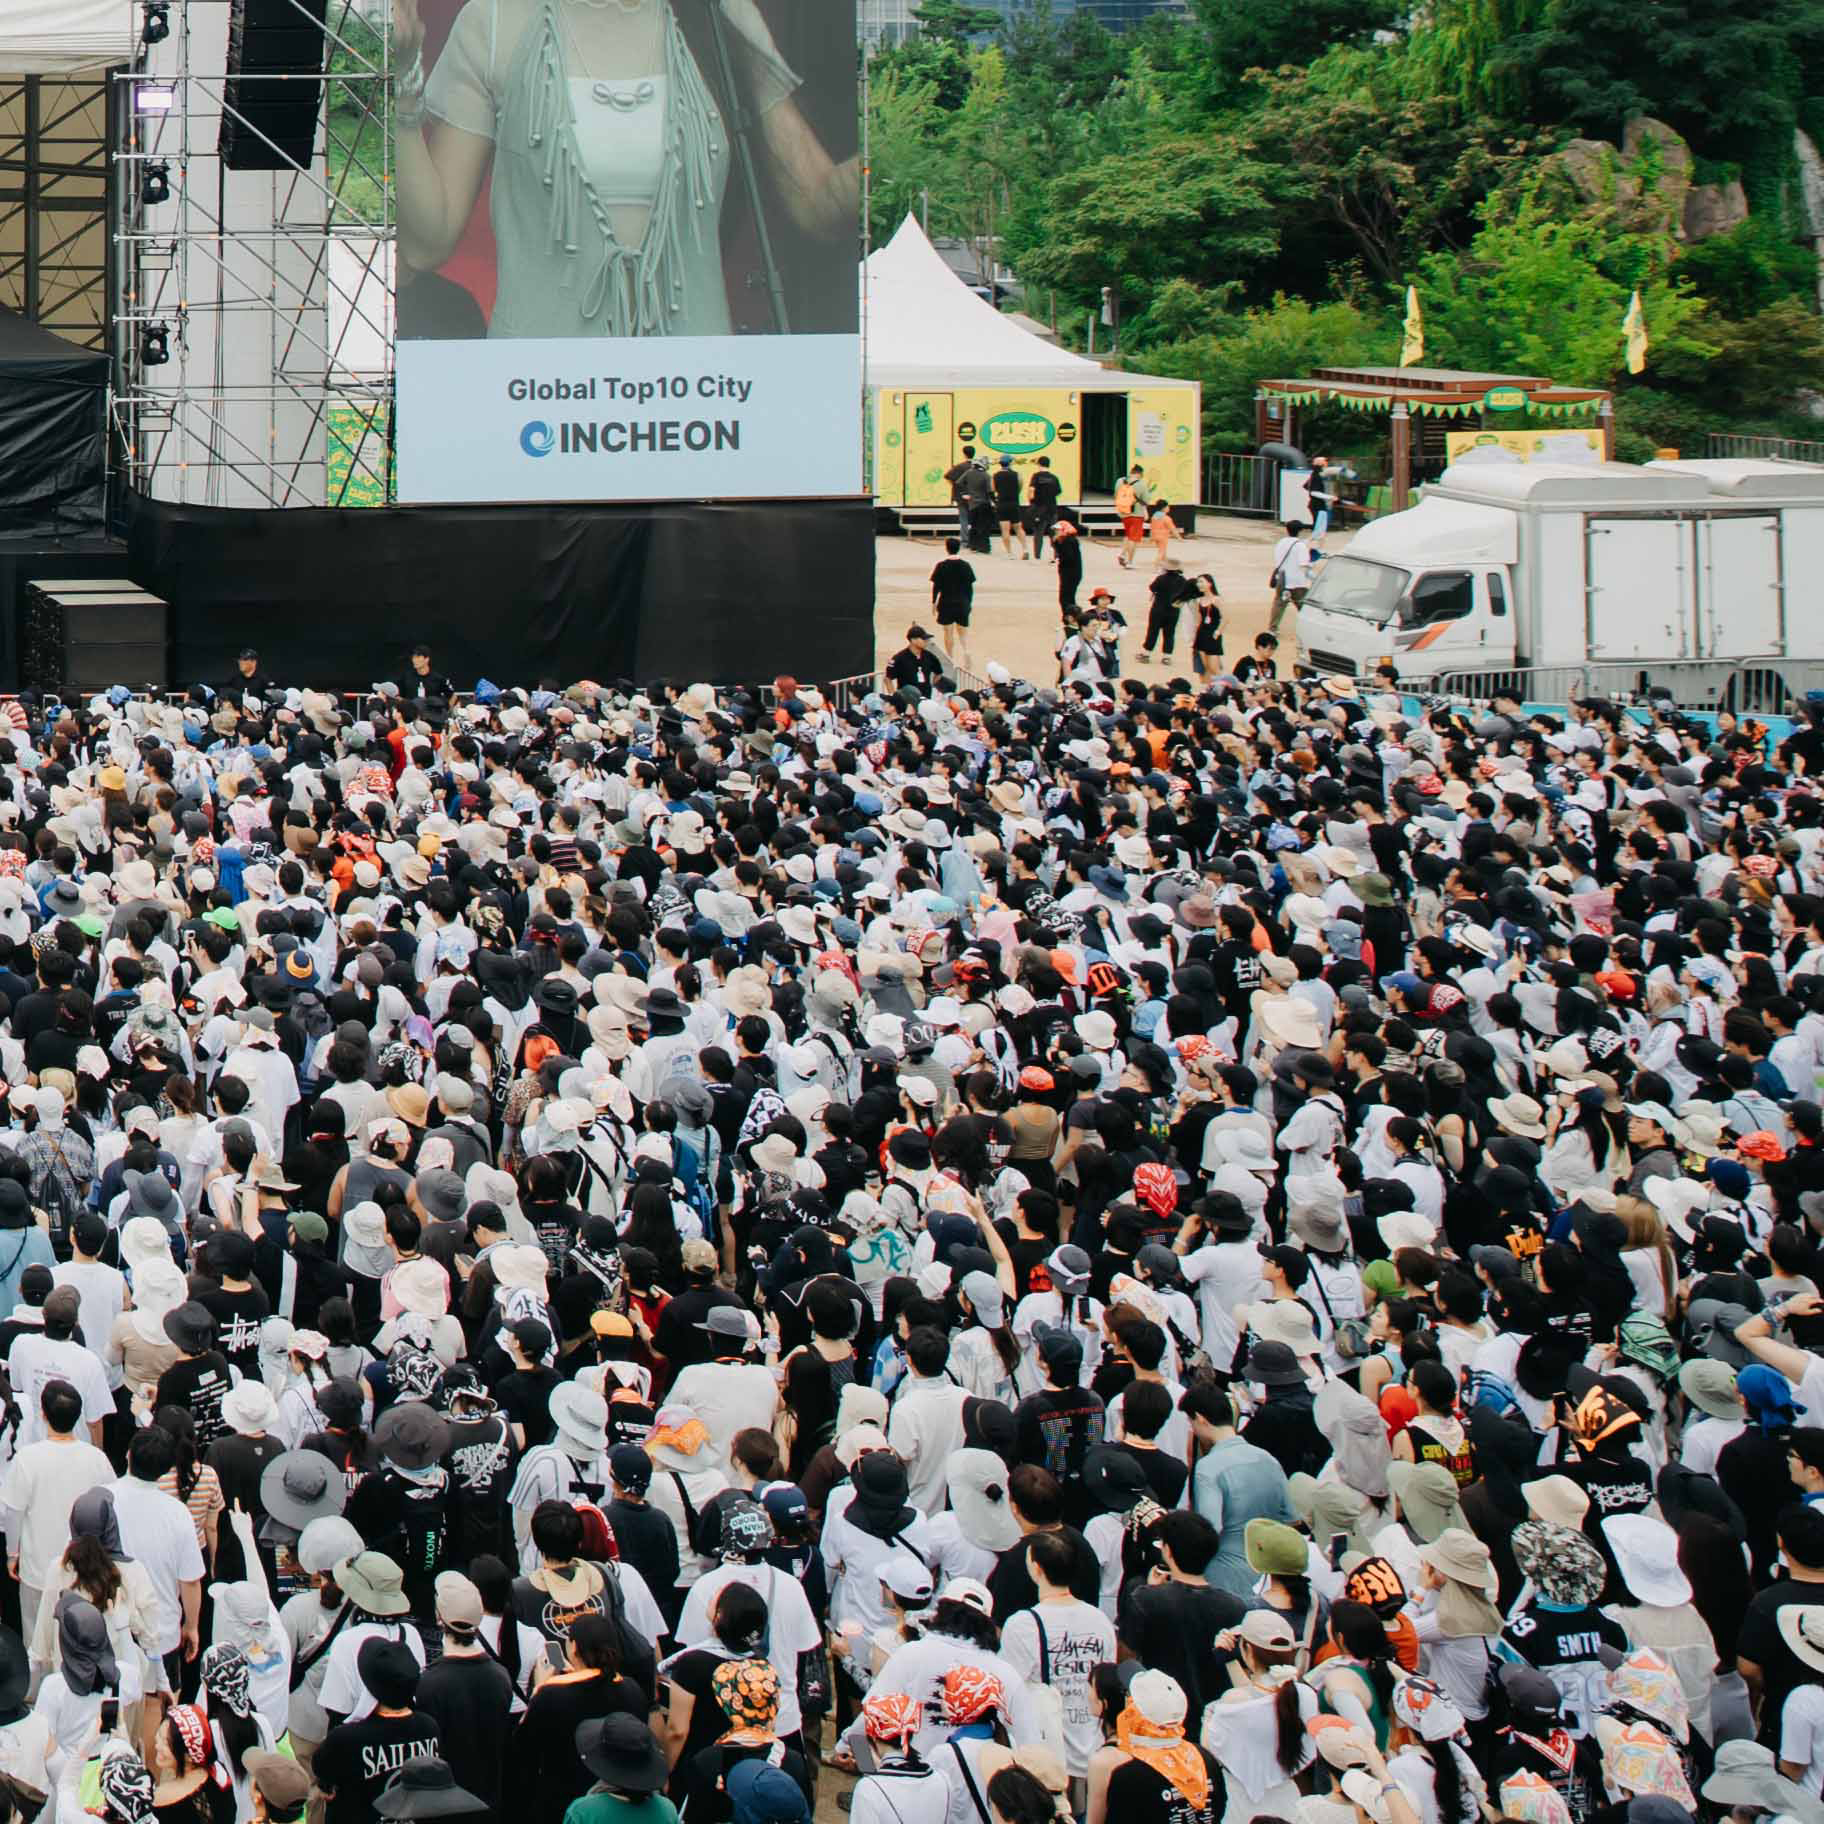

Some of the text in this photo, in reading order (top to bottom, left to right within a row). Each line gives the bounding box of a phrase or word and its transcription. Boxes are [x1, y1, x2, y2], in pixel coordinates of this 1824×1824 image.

[507, 374, 753, 404] Global Top10 City
[560, 420, 740, 453] INCHEON
